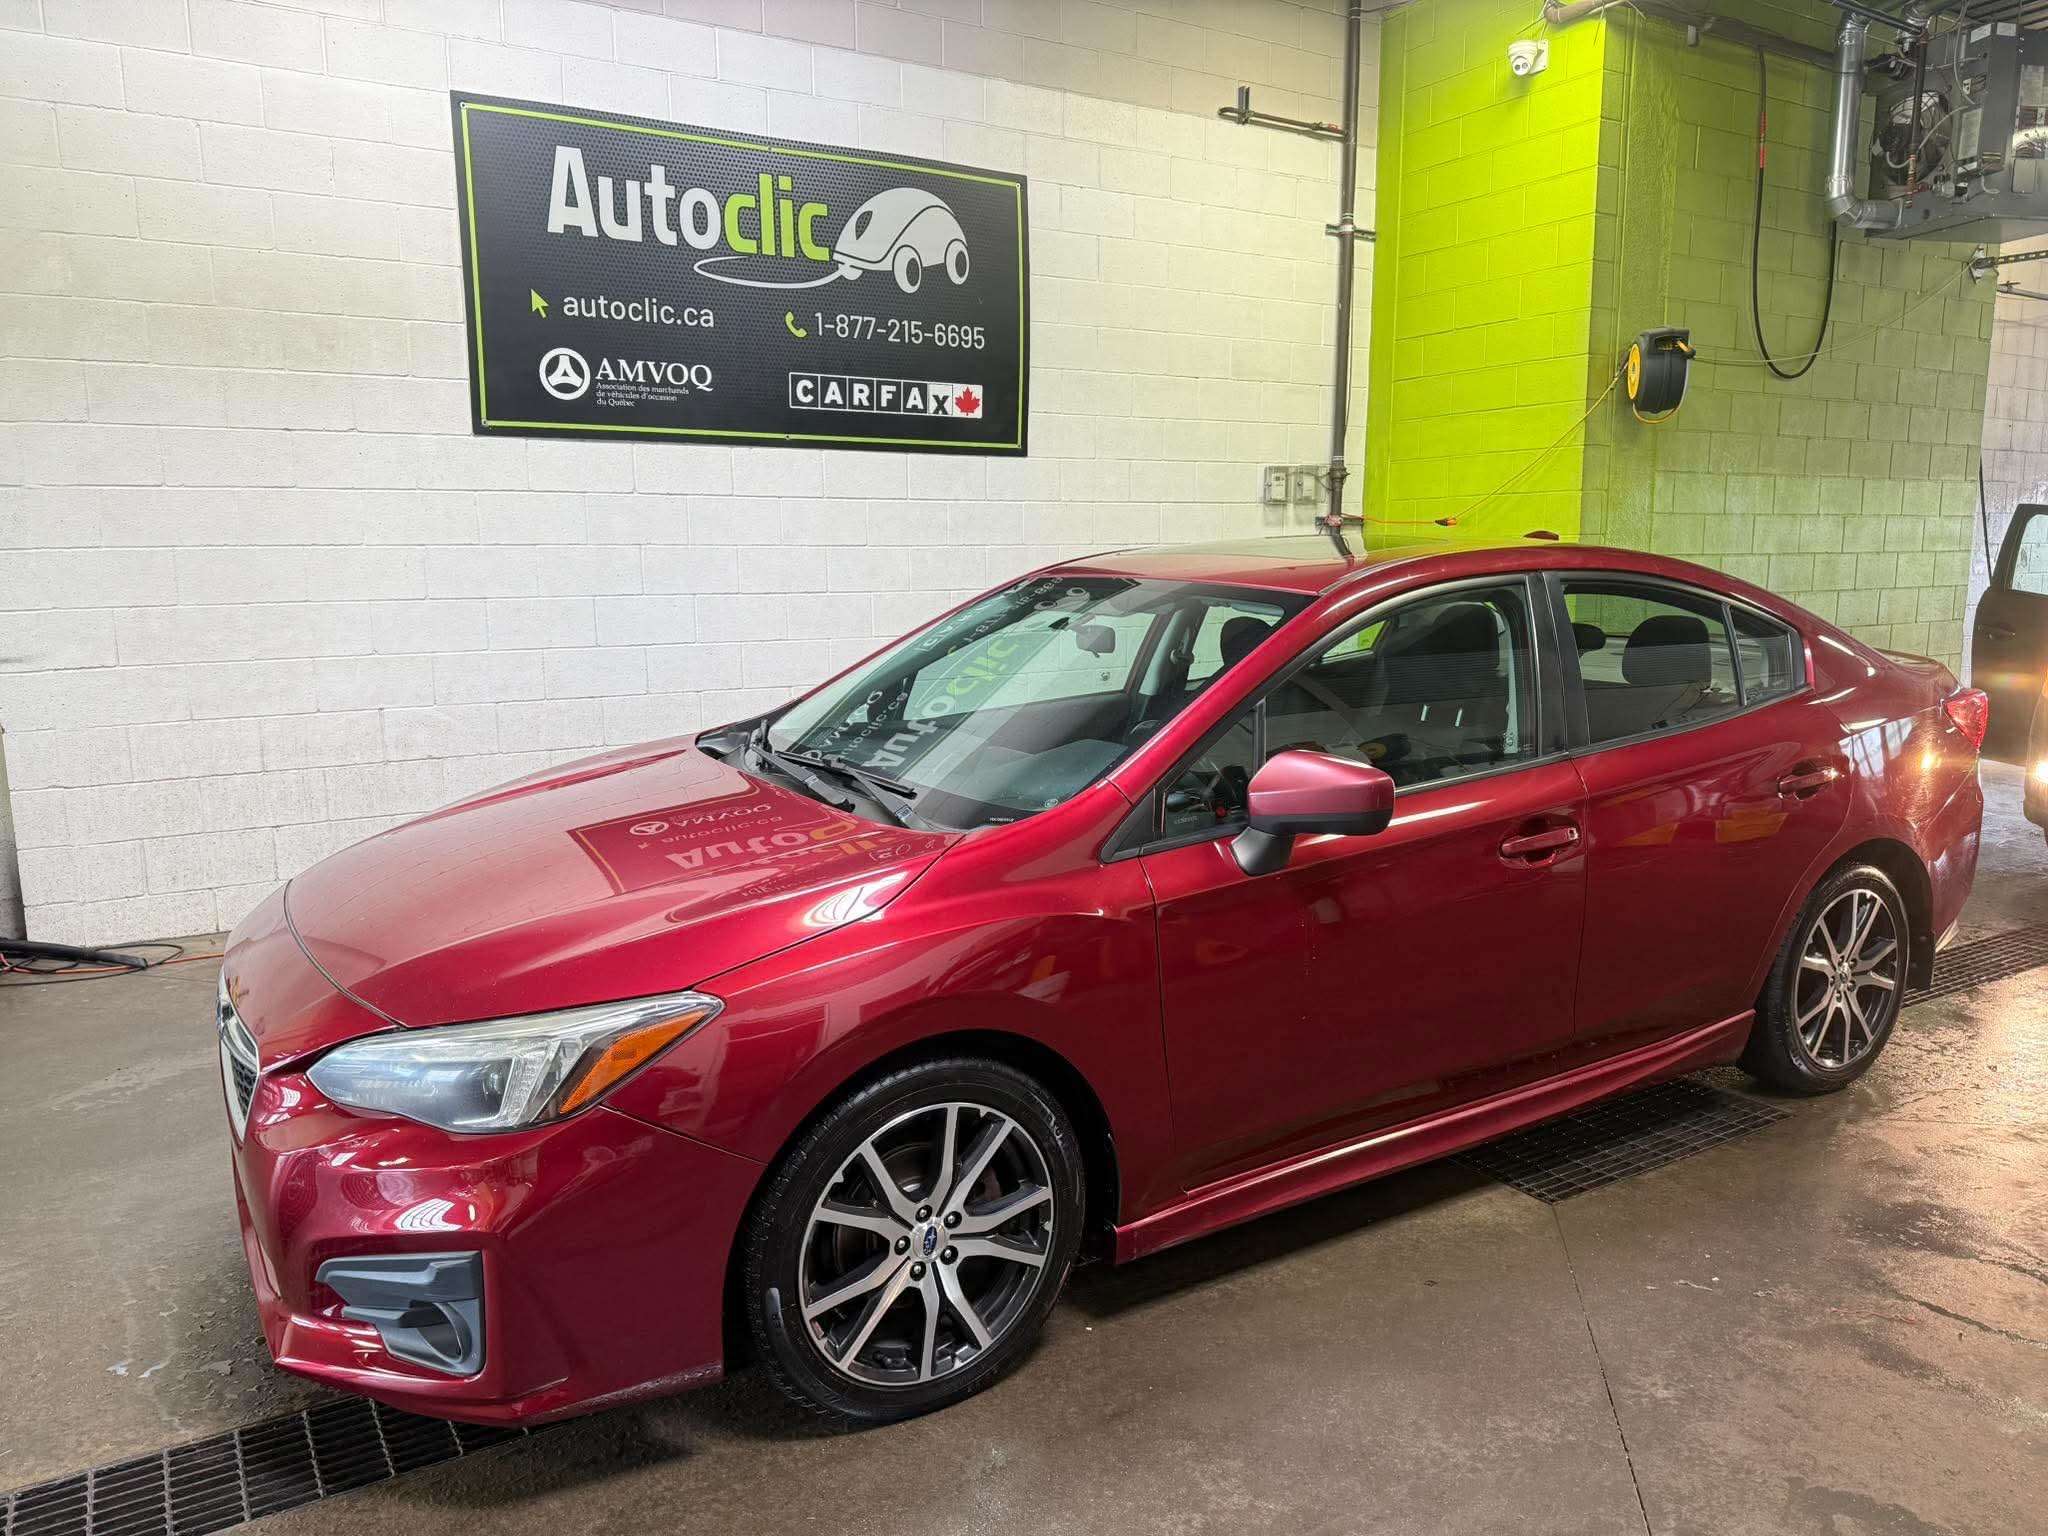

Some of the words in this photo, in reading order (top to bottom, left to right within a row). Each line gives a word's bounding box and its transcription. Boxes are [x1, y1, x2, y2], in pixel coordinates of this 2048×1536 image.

[547, 145, 830, 262] Autoclic
[562, 295, 715, 328] autoclic.ca
[814, 312, 985, 349] 1-877-215-6695
[595, 357, 713, 391] AMVOQ
[596, 382, 637, 392] Association
[638, 384, 650, 392] des
[651, 385, 689, 395] marchands
[596, 390, 605, 398] de
[596, 398, 607, 406] du
[795, 379, 951, 415] CARFAX
